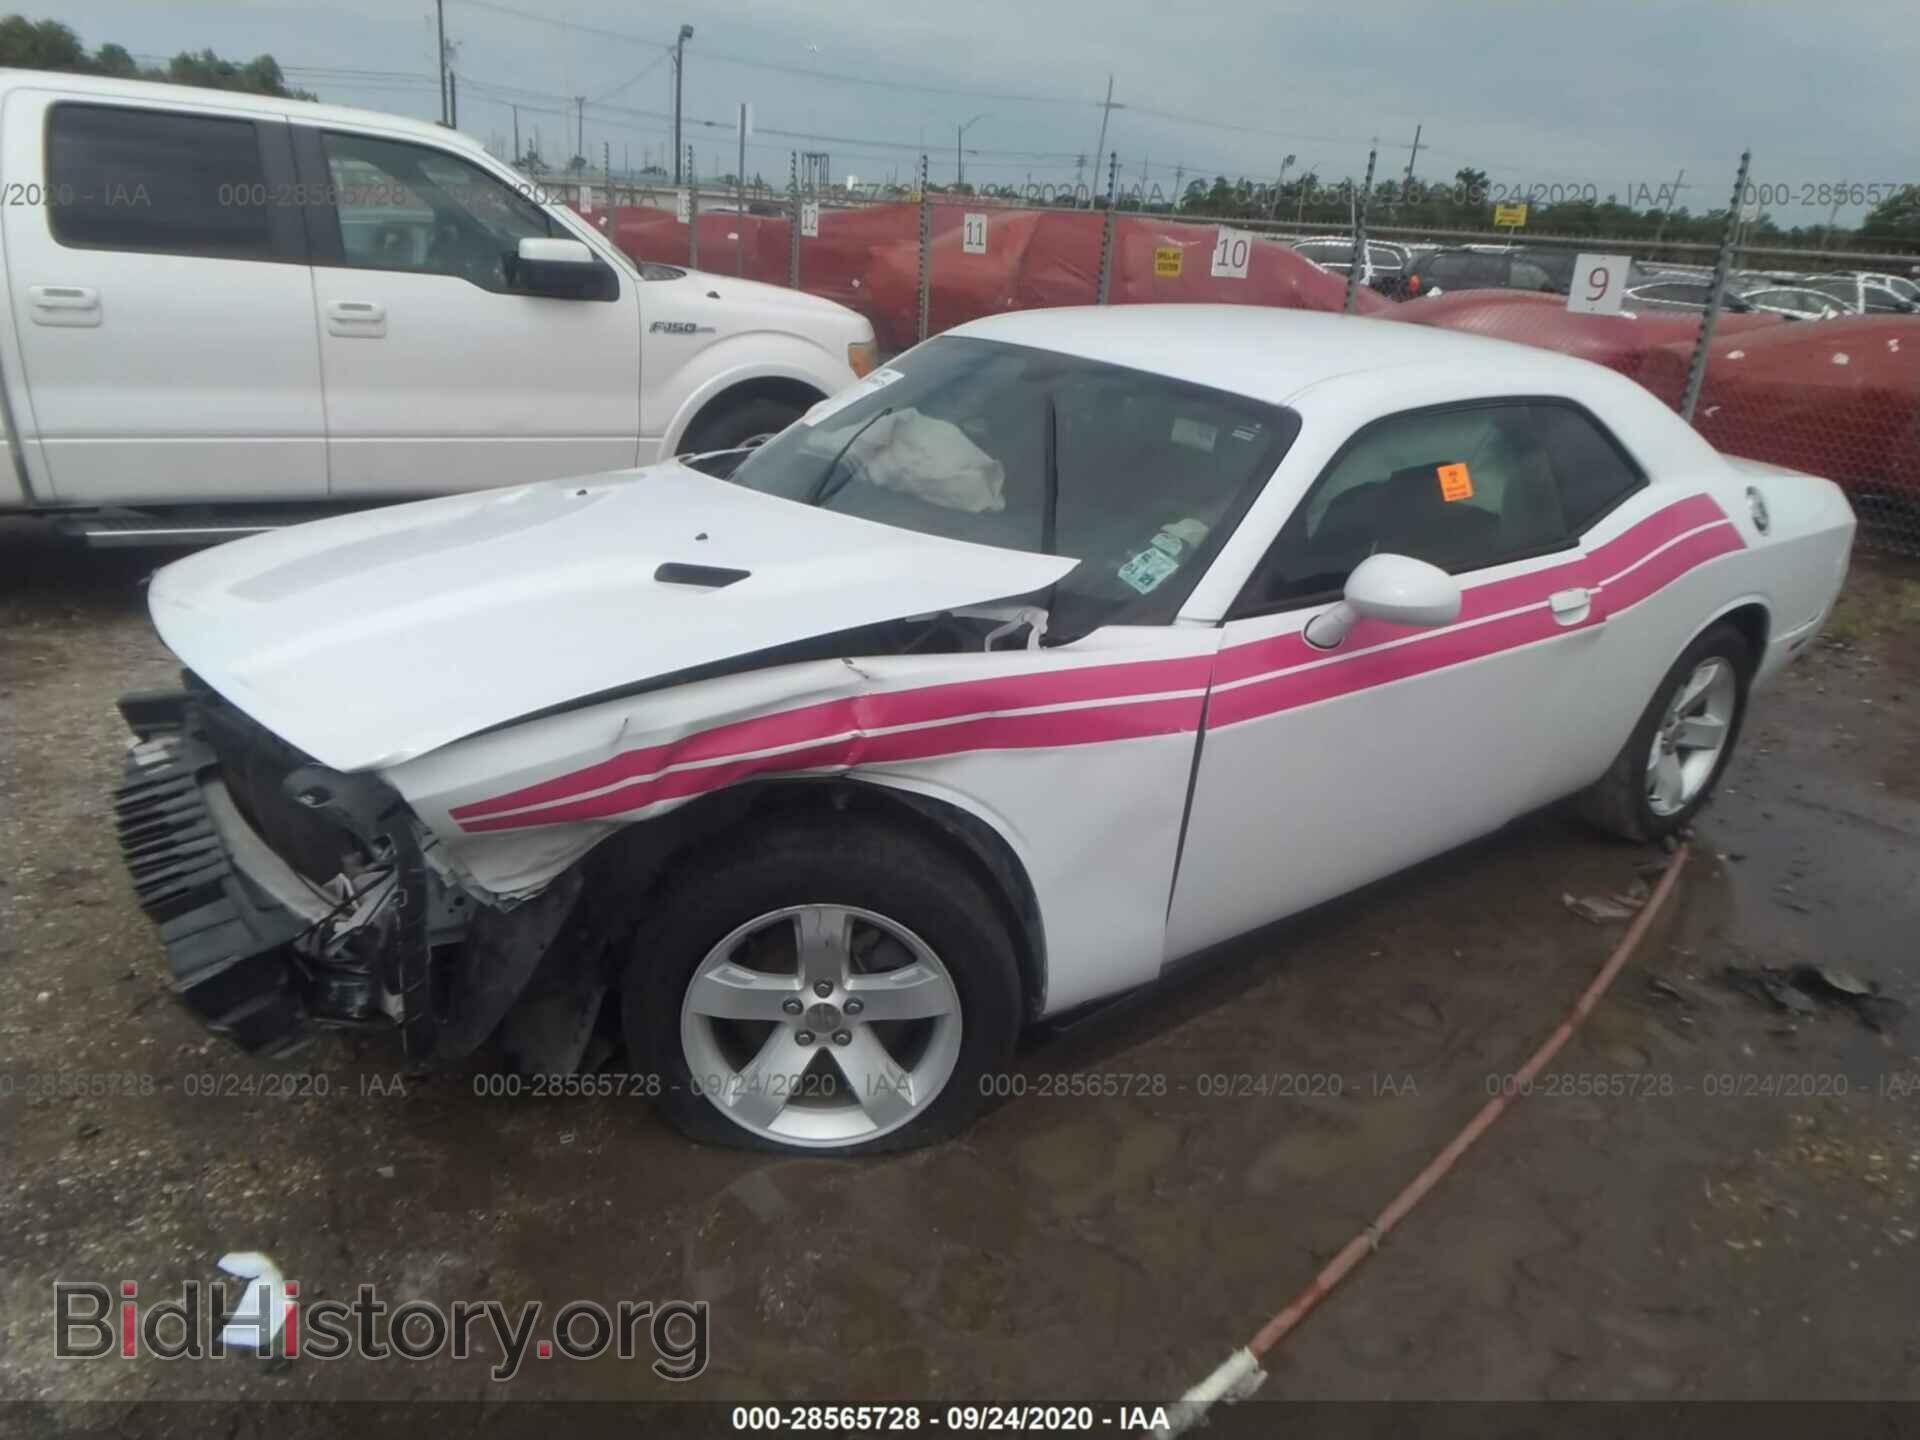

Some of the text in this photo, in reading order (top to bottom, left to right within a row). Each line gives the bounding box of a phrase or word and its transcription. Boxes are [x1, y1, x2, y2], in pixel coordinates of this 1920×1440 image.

[802, 208, 817, 231] 12
[965, 221, 985, 247] 11
[1216, 239, 1248, 269] 10
[1585, 266, 1609, 301] 9
